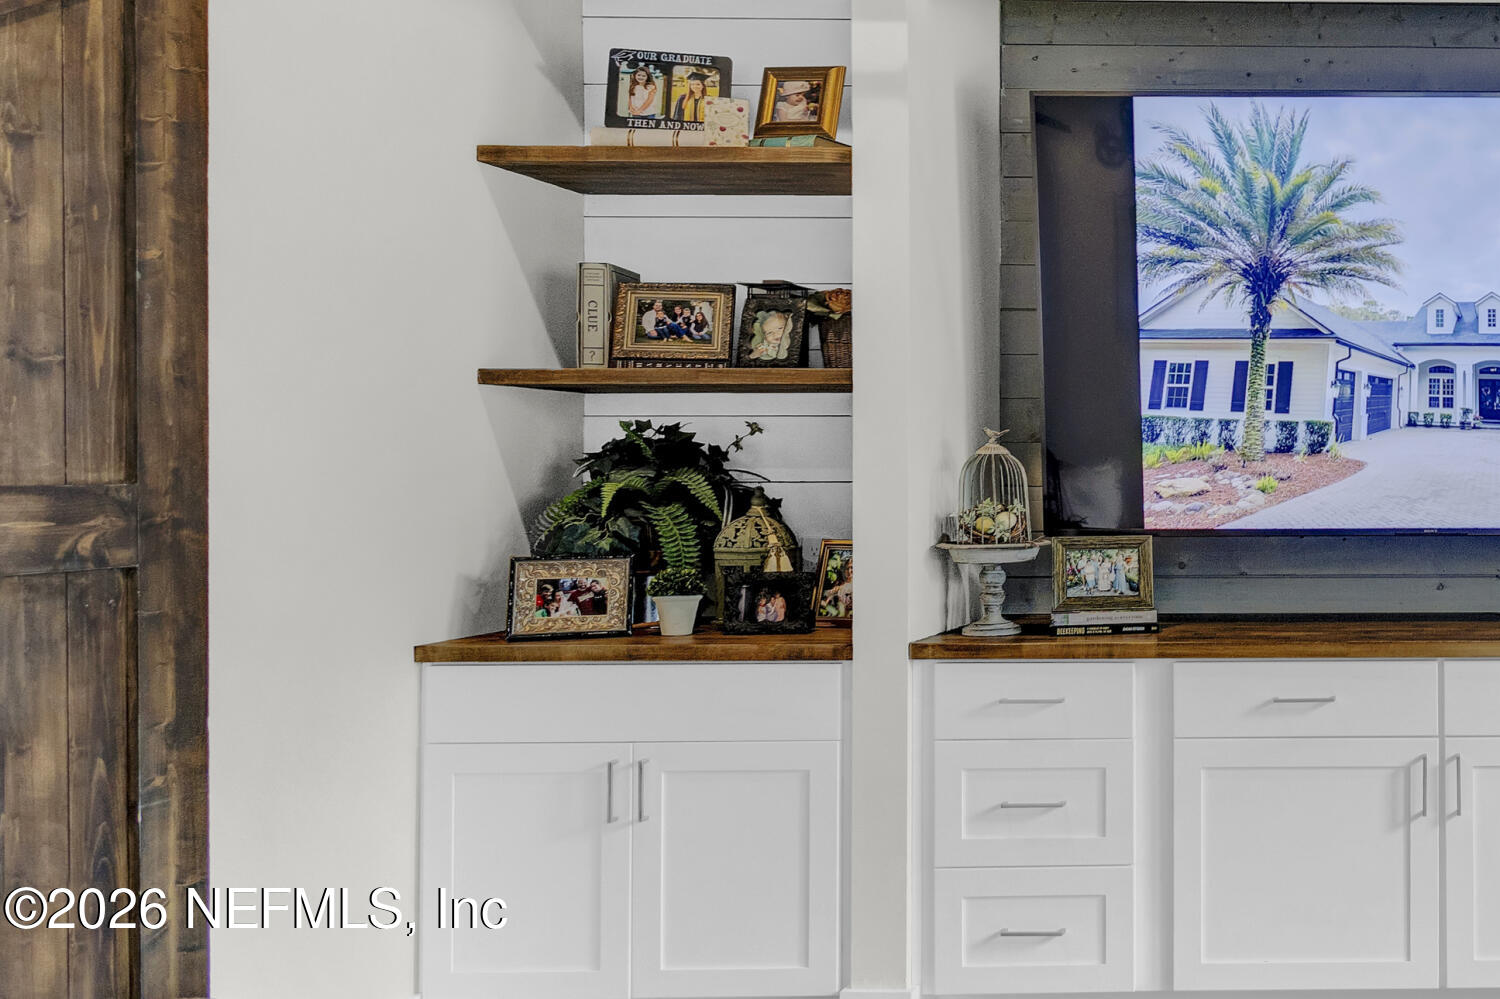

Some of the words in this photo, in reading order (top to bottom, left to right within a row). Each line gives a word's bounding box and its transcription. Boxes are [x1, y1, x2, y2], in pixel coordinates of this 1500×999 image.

[636, 51, 658, 61] OUR
[660, 52, 713, 65] GRADUATE
[626, 118, 656, 128] THEN
[658, 121, 681, 130] AND
[587, 300, 598, 333] CLUE
